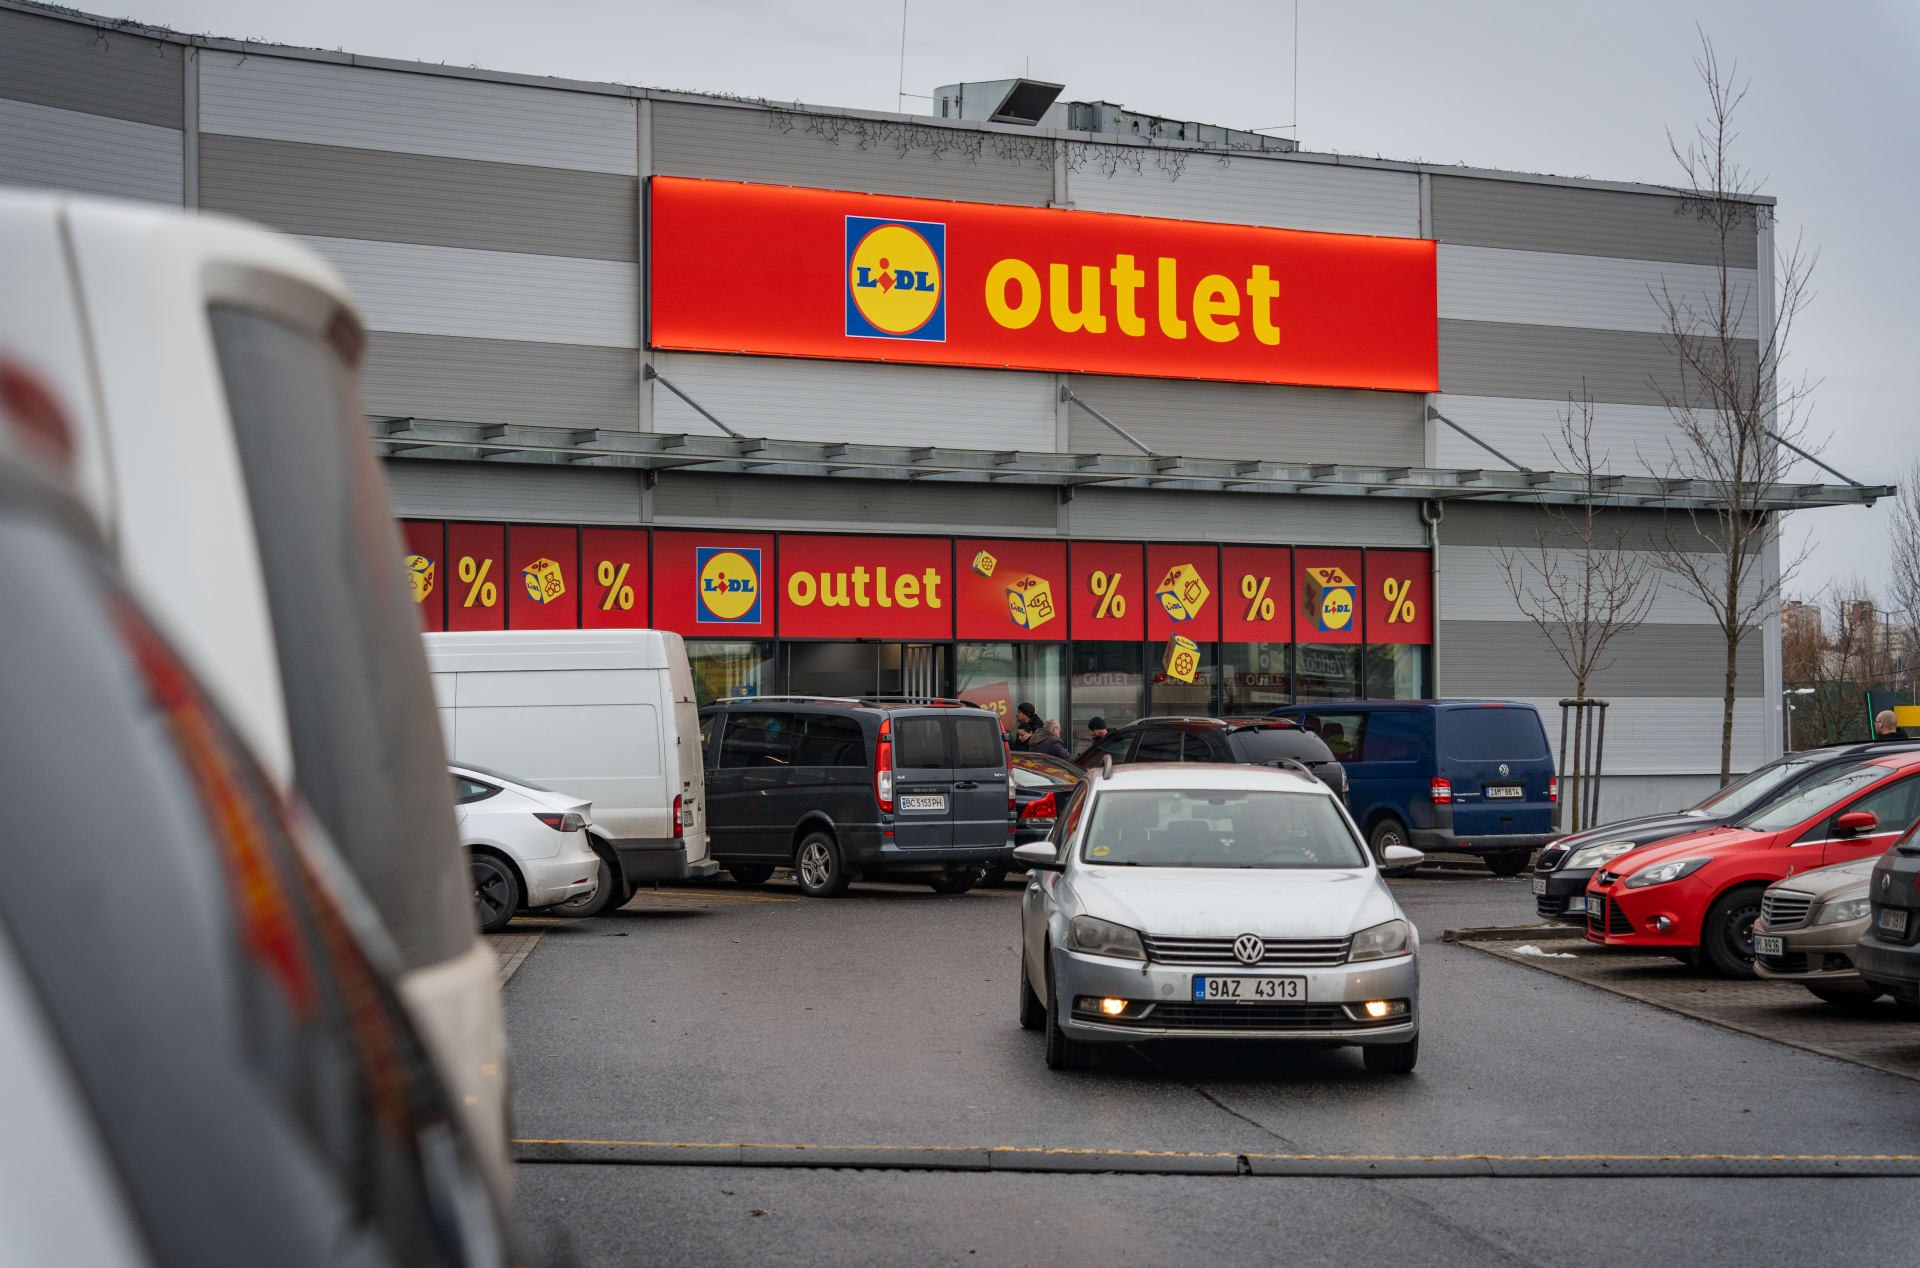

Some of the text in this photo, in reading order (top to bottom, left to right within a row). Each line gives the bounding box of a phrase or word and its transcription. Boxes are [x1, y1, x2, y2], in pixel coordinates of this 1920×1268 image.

[985, 254, 1281, 346] outlet
[458, 556, 497, 608] %
[597, 560, 635, 611] %
[787, 566, 942, 609] outlet
[1091, 570, 1127, 619] %
[1241, 574, 1276, 621] %
[1383, 577, 1415, 623] %
[1084, 673, 1128, 685] OUTLET
[1209, 980, 1241, 997] 9AZ
[1255, 980, 1297, 997] 4313
